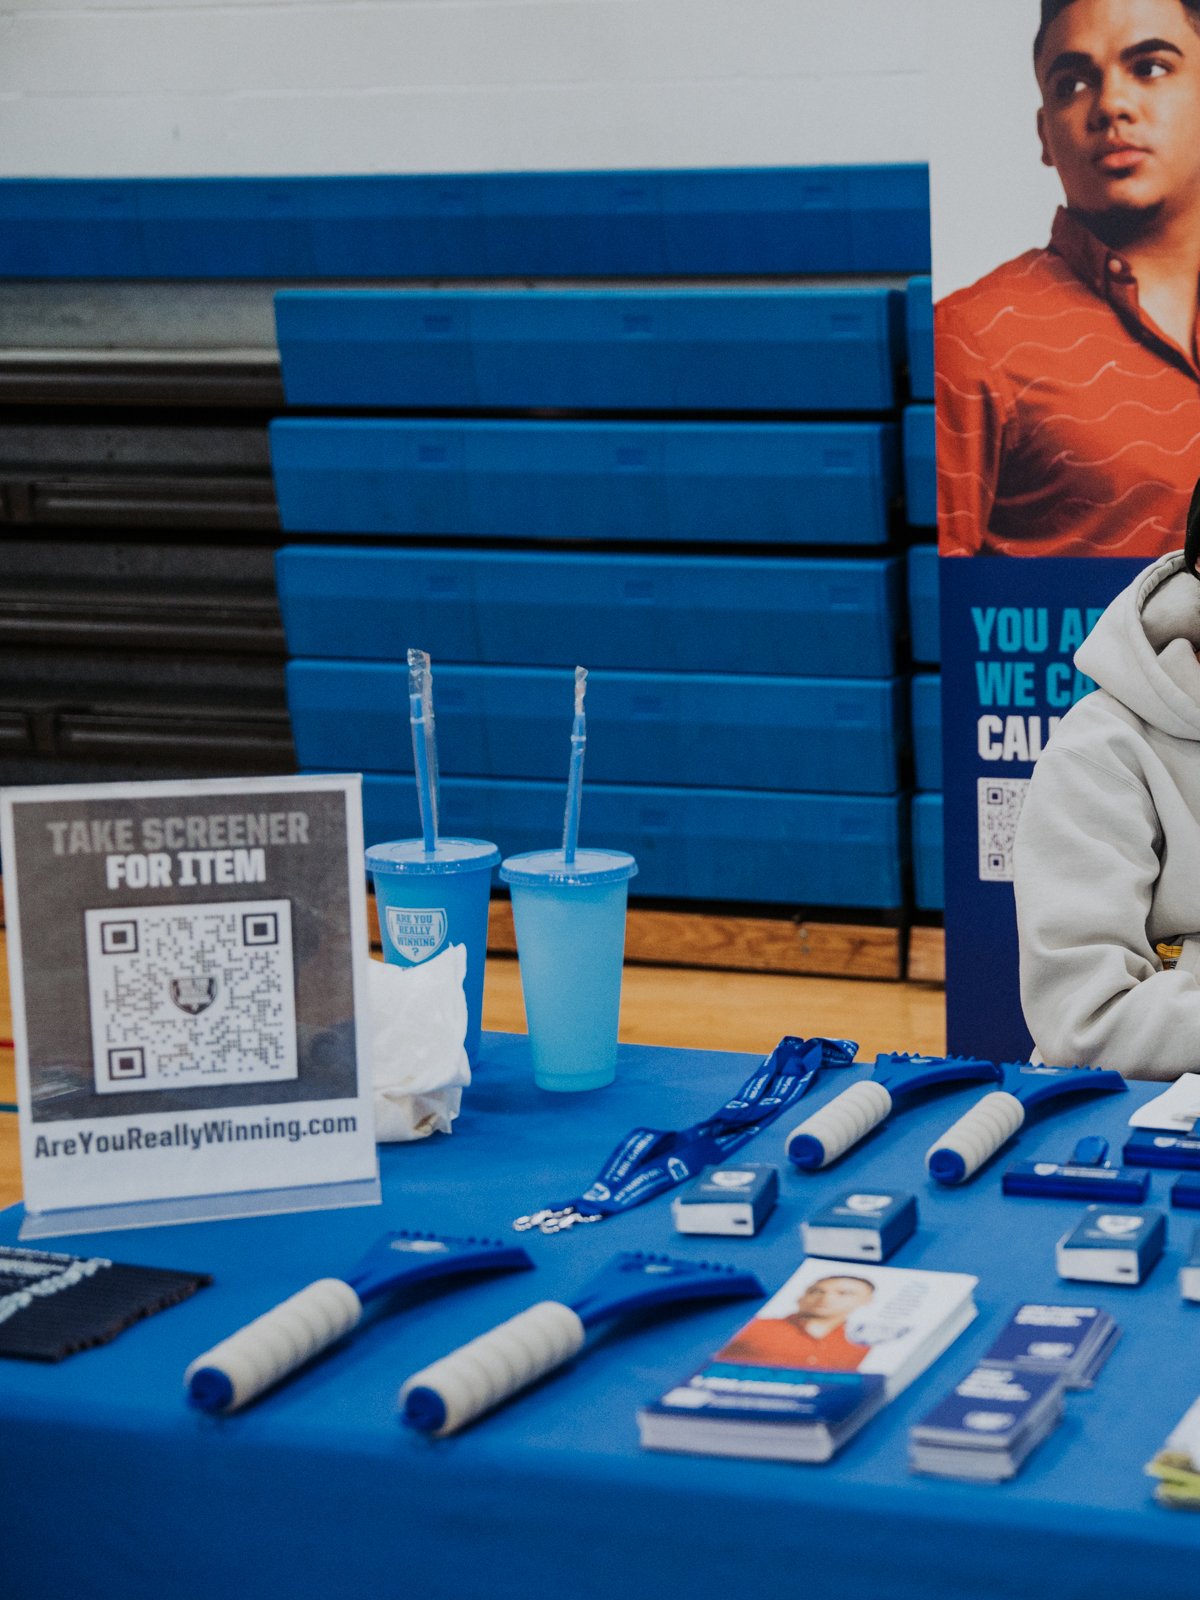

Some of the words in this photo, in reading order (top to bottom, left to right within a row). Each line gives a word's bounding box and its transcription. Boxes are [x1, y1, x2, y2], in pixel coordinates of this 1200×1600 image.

[971, 606, 1048, 653] YOU
[975, 661, 1036, 707] WE
[47, 818, 134, 855] TAKE
[141, 811, 310, 850] SCREENER
[106, 852, 173, 890] FOR
[177, 848, 267, 886] ITEM
[399, 925, 431, 935] REALLY
[413, 914, 432, 924] YOU
[397, 937, 435, 946] WINNING
[34, 1115, 357, 1159] AreYouReallyWinning.com
